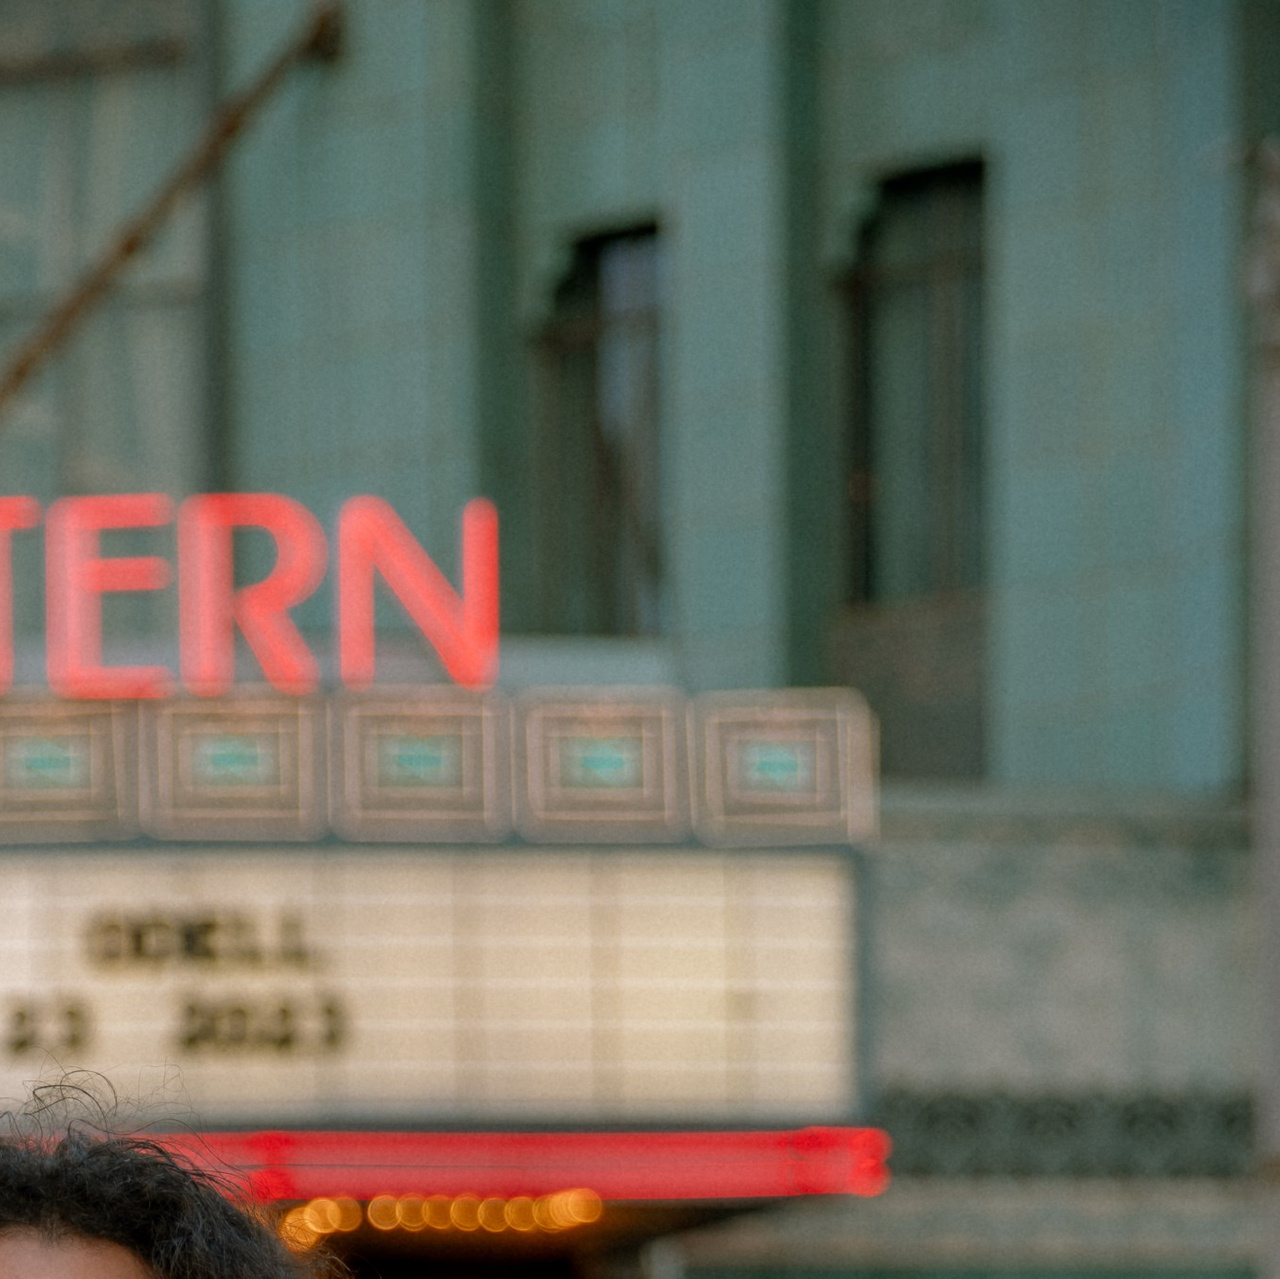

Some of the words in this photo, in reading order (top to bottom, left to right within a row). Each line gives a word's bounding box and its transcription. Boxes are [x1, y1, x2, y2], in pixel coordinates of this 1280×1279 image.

[86, 907, 321, 974] ODELL
[0, 997, 90, 1061] 23
[172, 994, 350, 1056] 2023
